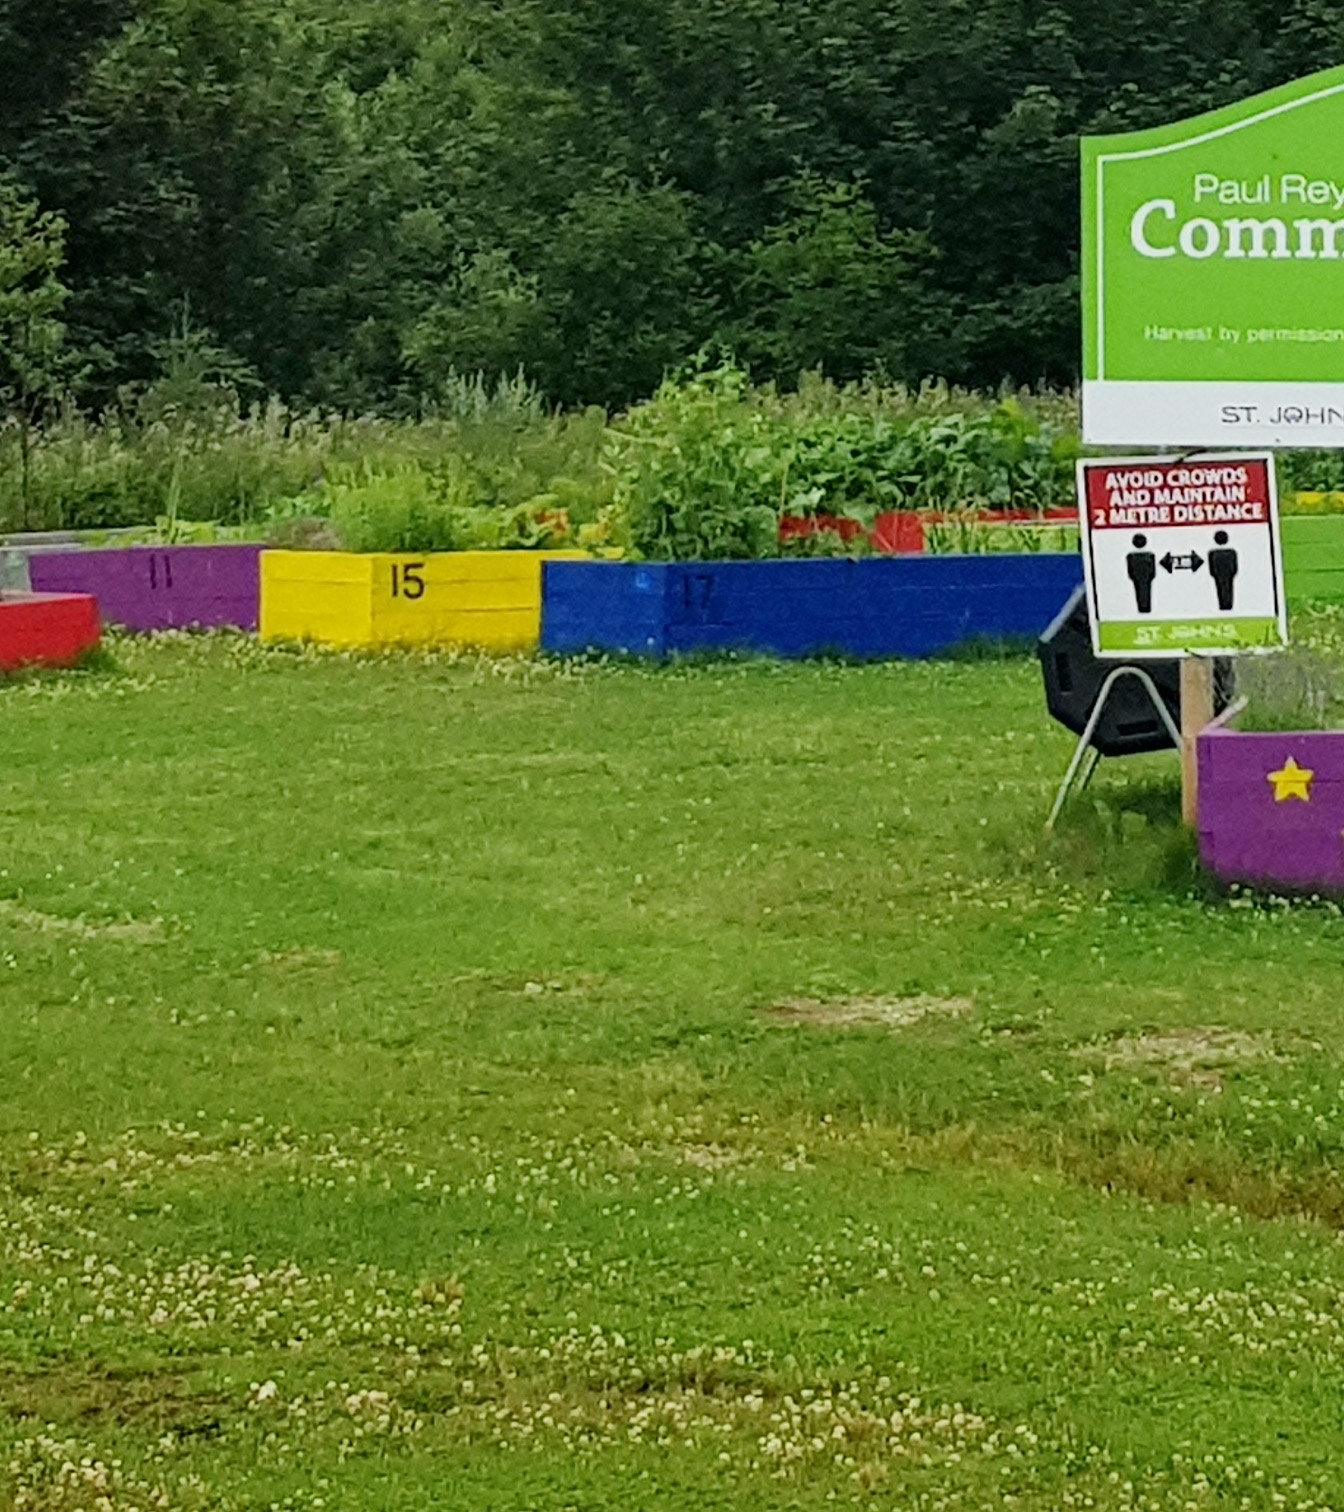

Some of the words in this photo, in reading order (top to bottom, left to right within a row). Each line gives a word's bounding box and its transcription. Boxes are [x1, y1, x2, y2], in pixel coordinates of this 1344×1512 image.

[1193, 174, 1270, 204] Paul
[1144, 325, 1212, 341] Harvest
[1218, 326, 1240, 343] by
[1246, 326, 1344, 343] permission
[1221, 406, 1261, 424] ST.
[1106, 471, 1164, 489] AVOID
[1167, 467, 1248, 487] CROWDS
[1110, 489, 1151, 506] AND
[1154, 486, 1246, 504] MAINTAIN
[1094, 509, 1106, 525] 2
[1110, 507, 1170, 524] METRE
[1174, 503, 1264, 521] DISTANCE
[391, 562, 425, 600] 15
[683, 574, 715, 609] 17
